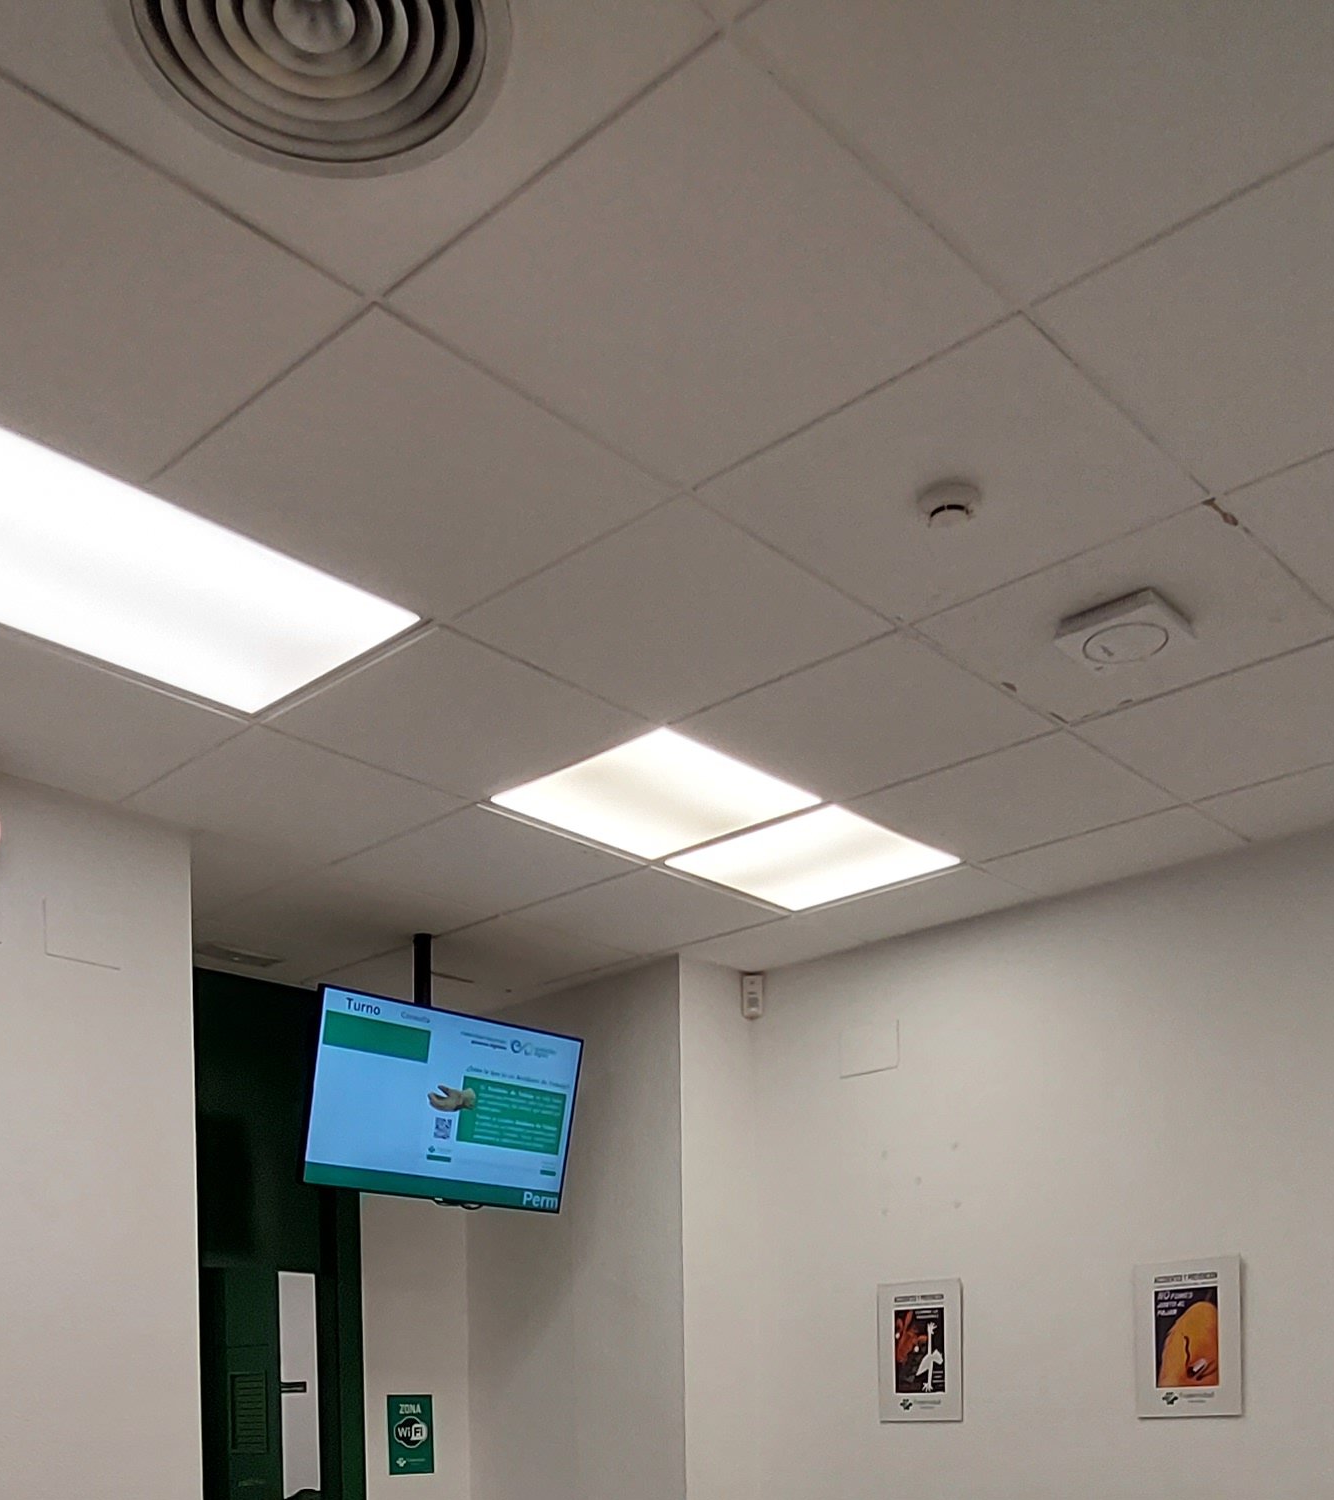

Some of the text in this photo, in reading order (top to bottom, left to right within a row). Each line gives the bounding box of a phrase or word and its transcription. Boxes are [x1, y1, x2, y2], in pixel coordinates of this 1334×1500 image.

[345, 997, 381, 1016] Turno
[522, 1191, 559, 1209] Perm
[398, 1403, 422, 1415] ZONA
